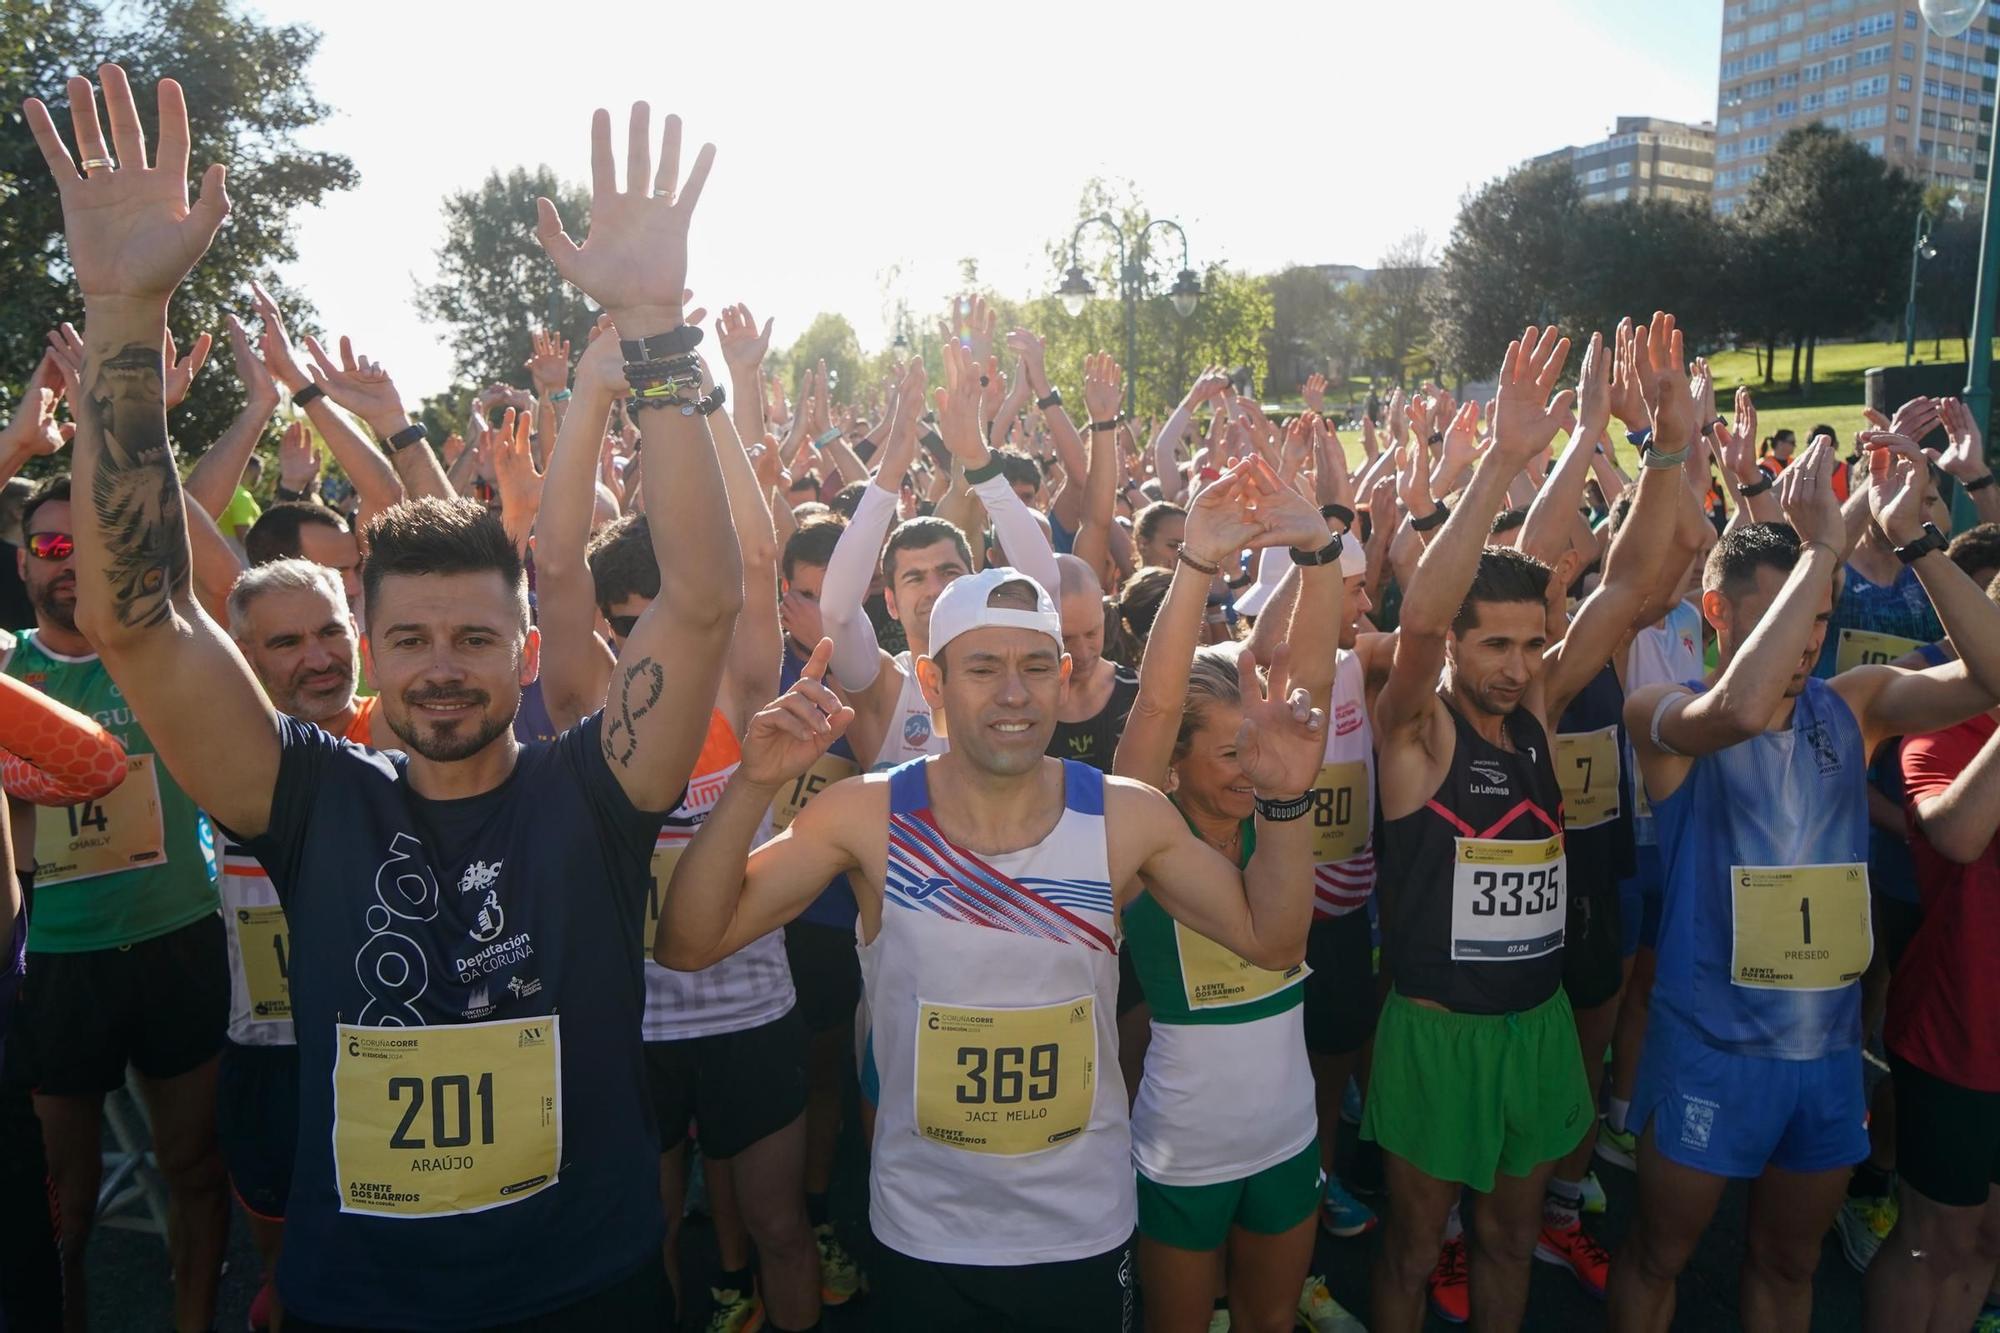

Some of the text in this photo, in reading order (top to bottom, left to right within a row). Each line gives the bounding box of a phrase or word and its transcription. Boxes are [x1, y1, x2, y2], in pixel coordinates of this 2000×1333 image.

[1470, 784, 1480, 793] La
[1576, 756, 1592, 793] 7
[1314, 786, 1352, 827] 80
[1472, 865, 1558, 916] 3335
[1800, 897, 1811, 944] 1
[455, 931, 531, 972] Deputación
[460, 944, 535, 984] DA CORUÑA
[1506, 944, 1530, 953] 07.04
[1784, 950, 1830, 960] PRESEDO
[956, 1043, 1059, 1104] 369
[388, 1072, 495, 1149] 201
[965, 1107, 1047, 1122] JACI MELLO
[411, 1155, 474, 1172] ARAÚJO
[351, 1190, 420, 1202] DOS BARRIOS
[359, 1182, 392, 1193] XENTE
